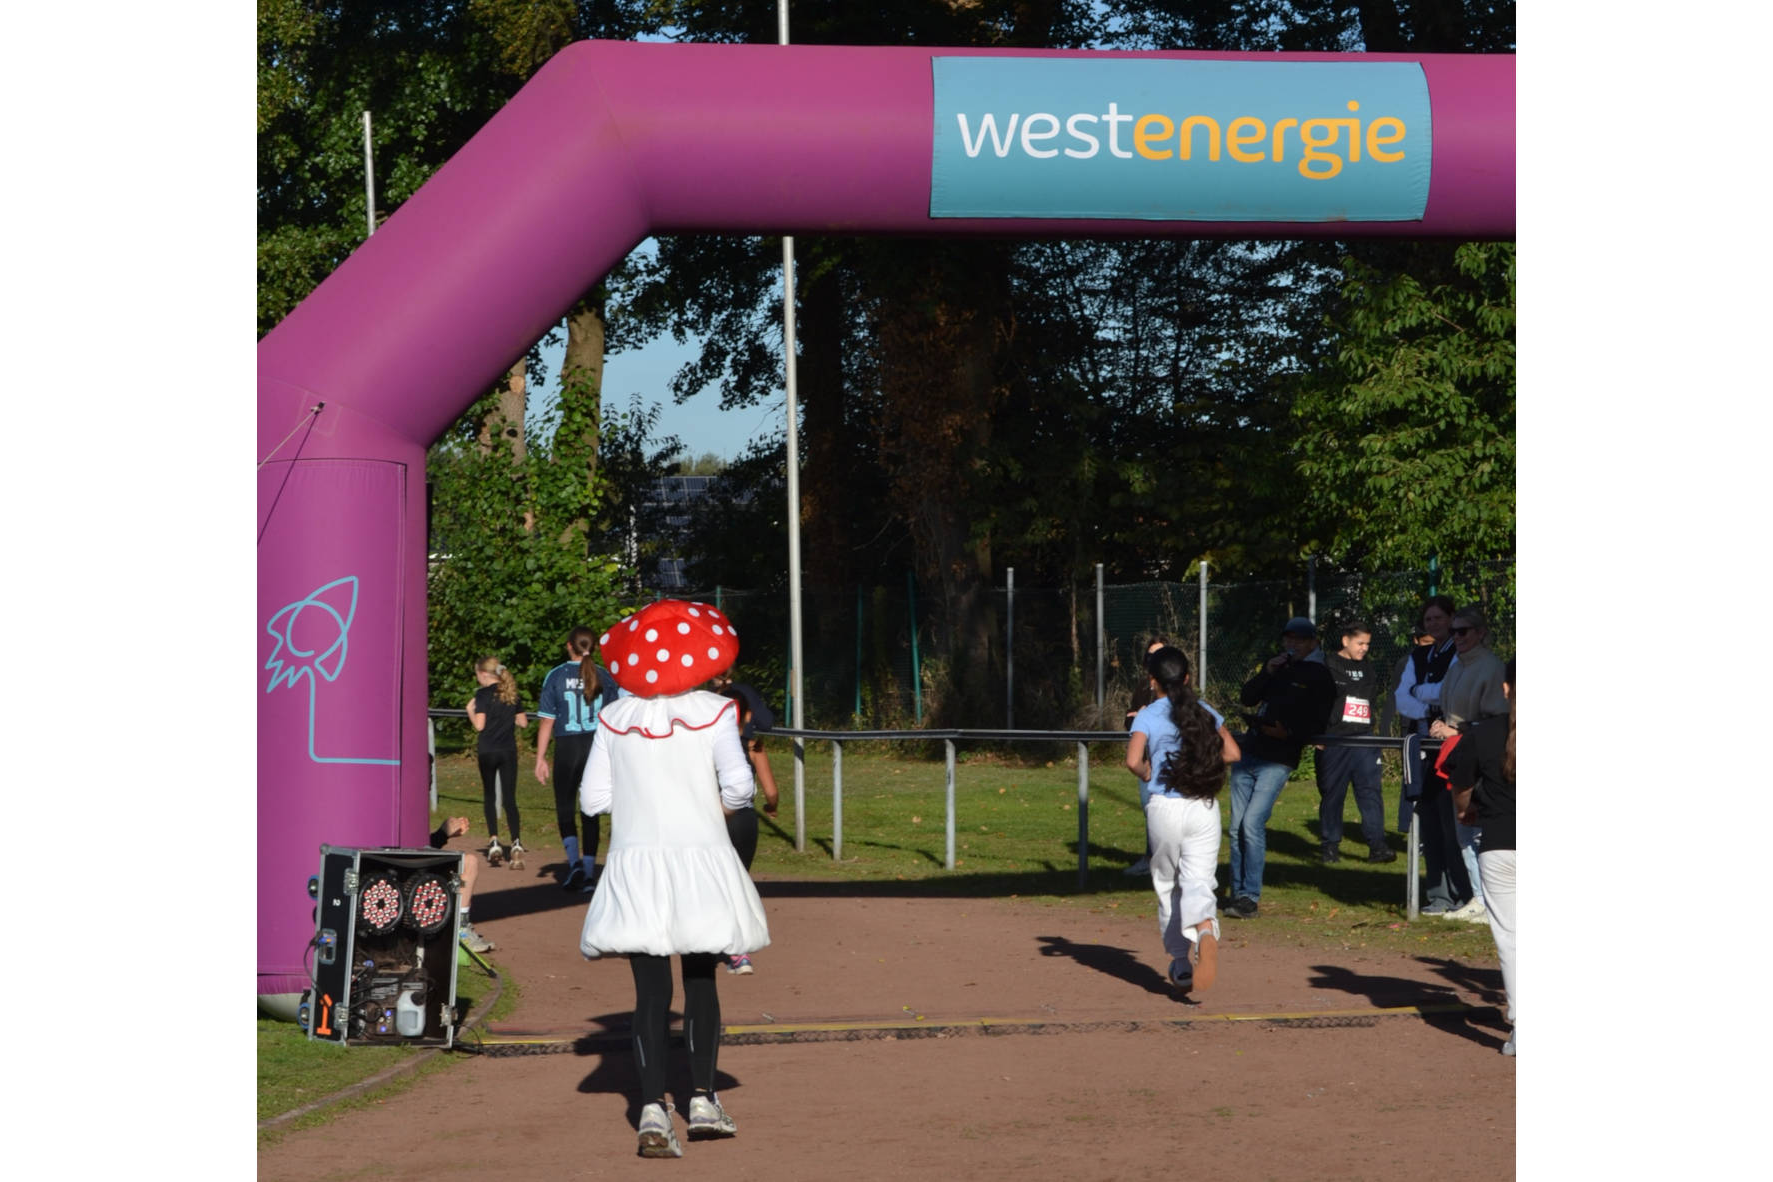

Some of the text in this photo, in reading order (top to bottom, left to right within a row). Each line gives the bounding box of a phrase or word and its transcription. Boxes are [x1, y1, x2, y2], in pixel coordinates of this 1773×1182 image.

[956, 100, 1407, 180] westenergie
[563, 691, 603, 731] 10
[1348, 704, 1368, 717] 249
